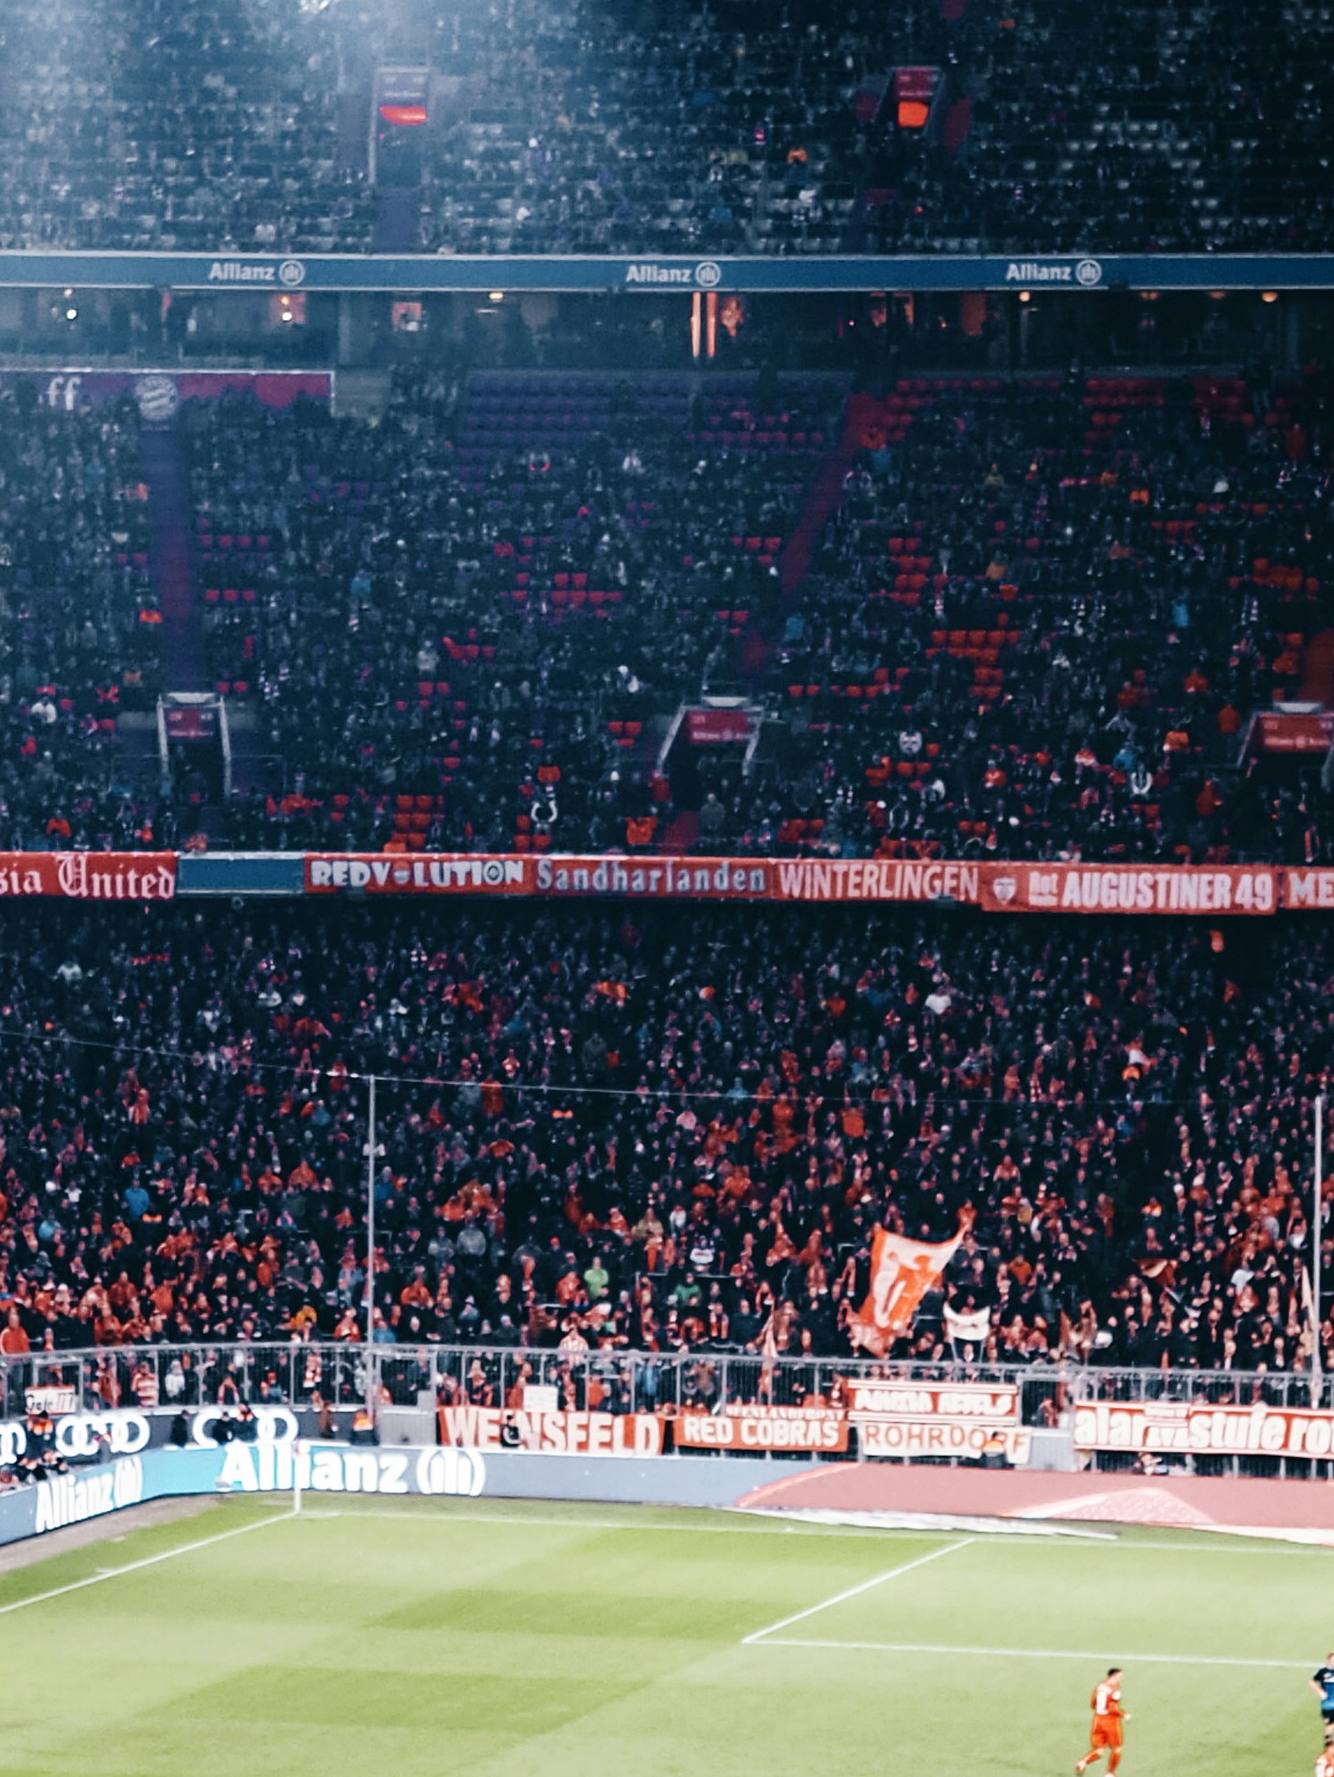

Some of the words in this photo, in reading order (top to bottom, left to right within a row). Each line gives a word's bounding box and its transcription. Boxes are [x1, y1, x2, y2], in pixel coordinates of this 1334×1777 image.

[209, 262, 275, 282] Allianz
[626, 263, 693, 285] Allianz
[1005, 262, 1073, 282] Allianz
[55, 852, 177, 899] United
[536, 858, 766, 893] Sandharlanden
[779, 864, 979, 901] WINTERLINGEN
[1062, 871, 1232, 909] AUGUSTINER
[1235, 873, 1273, 911] 49
[443, 1406, 661, 1458] WENSFELD
[683, 1418, 734, 1444] RED
[740, 1418, 839, 1447] COBRAS
[221, 1440, 409, 1493] Allianz
[35, 1472, 115, 1532] Allianz
